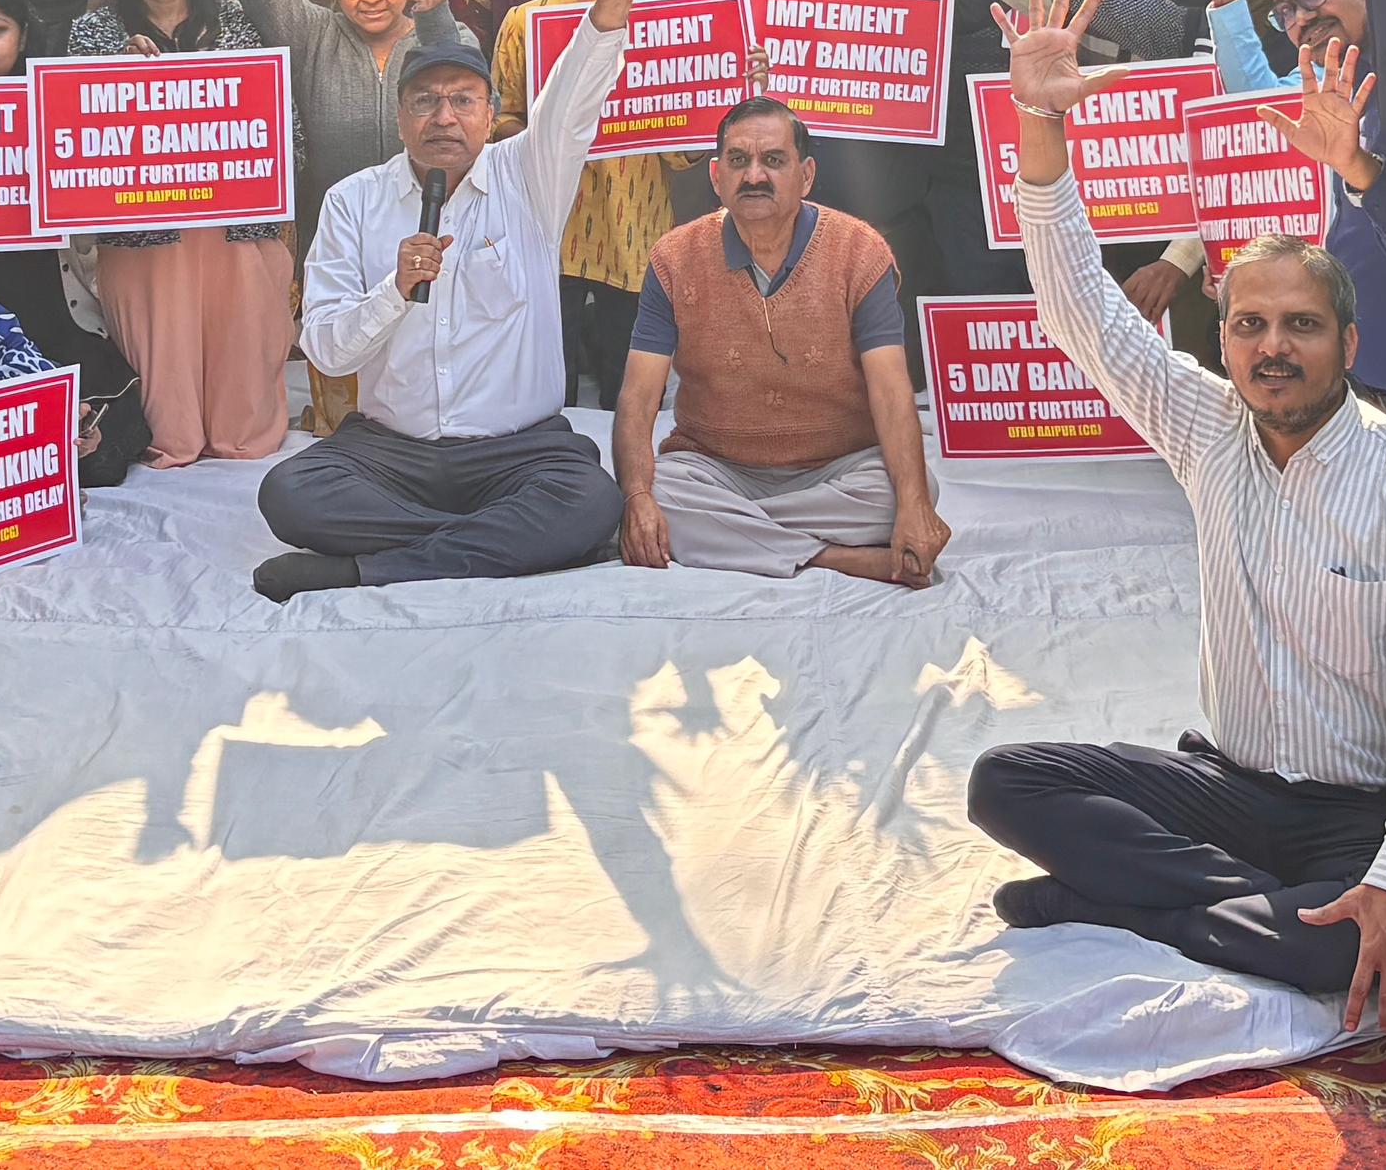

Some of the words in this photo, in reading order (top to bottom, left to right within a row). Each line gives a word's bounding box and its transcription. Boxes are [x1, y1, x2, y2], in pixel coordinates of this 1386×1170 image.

[767, 0, 909, 34] IMPLEMENT
[627, 52, 736, 88] BANKING
[816, 42, 927, 75] BANKING
[81, 77, 241, 113] IMPLEMENT
[624, 92, 692, 115] FURTHER
[696, 88, 742, 107] DELAY
[811, 78, 880, 99] FURTHER
[884, 83, 930, 102] DELAY
[814, 101, 850, 113] RAIPUR
[629, 117, 664, 130] RAIPUR
[55, 129, 73, 158] 5
[82, 126, 135, 157] DAY
[142, 119, 267, 154] BANKING
[50, 166, 136, 188] WITHOUT
[140, 162, 219, 184] FURTHER
[223, 158, 274, 179] DELAY
[1230, 166, 1315, 206] BANKING
[146, 189, 186, 202] RAIPUR
[1083, 177, 1163, 199] FURTHER
[1092, 204, 1133, 217] RAIPUR
[948, 364, 966, 392] 5
[972, 363, 1020, 391] DAY
[947, 402, 1025, 421] WITHOUT
[1029, 400, 1106, 420] FURTHER
[1037, 425, 1076, 437] RAIPUR
[25, 484, 64, 514] DELAY
